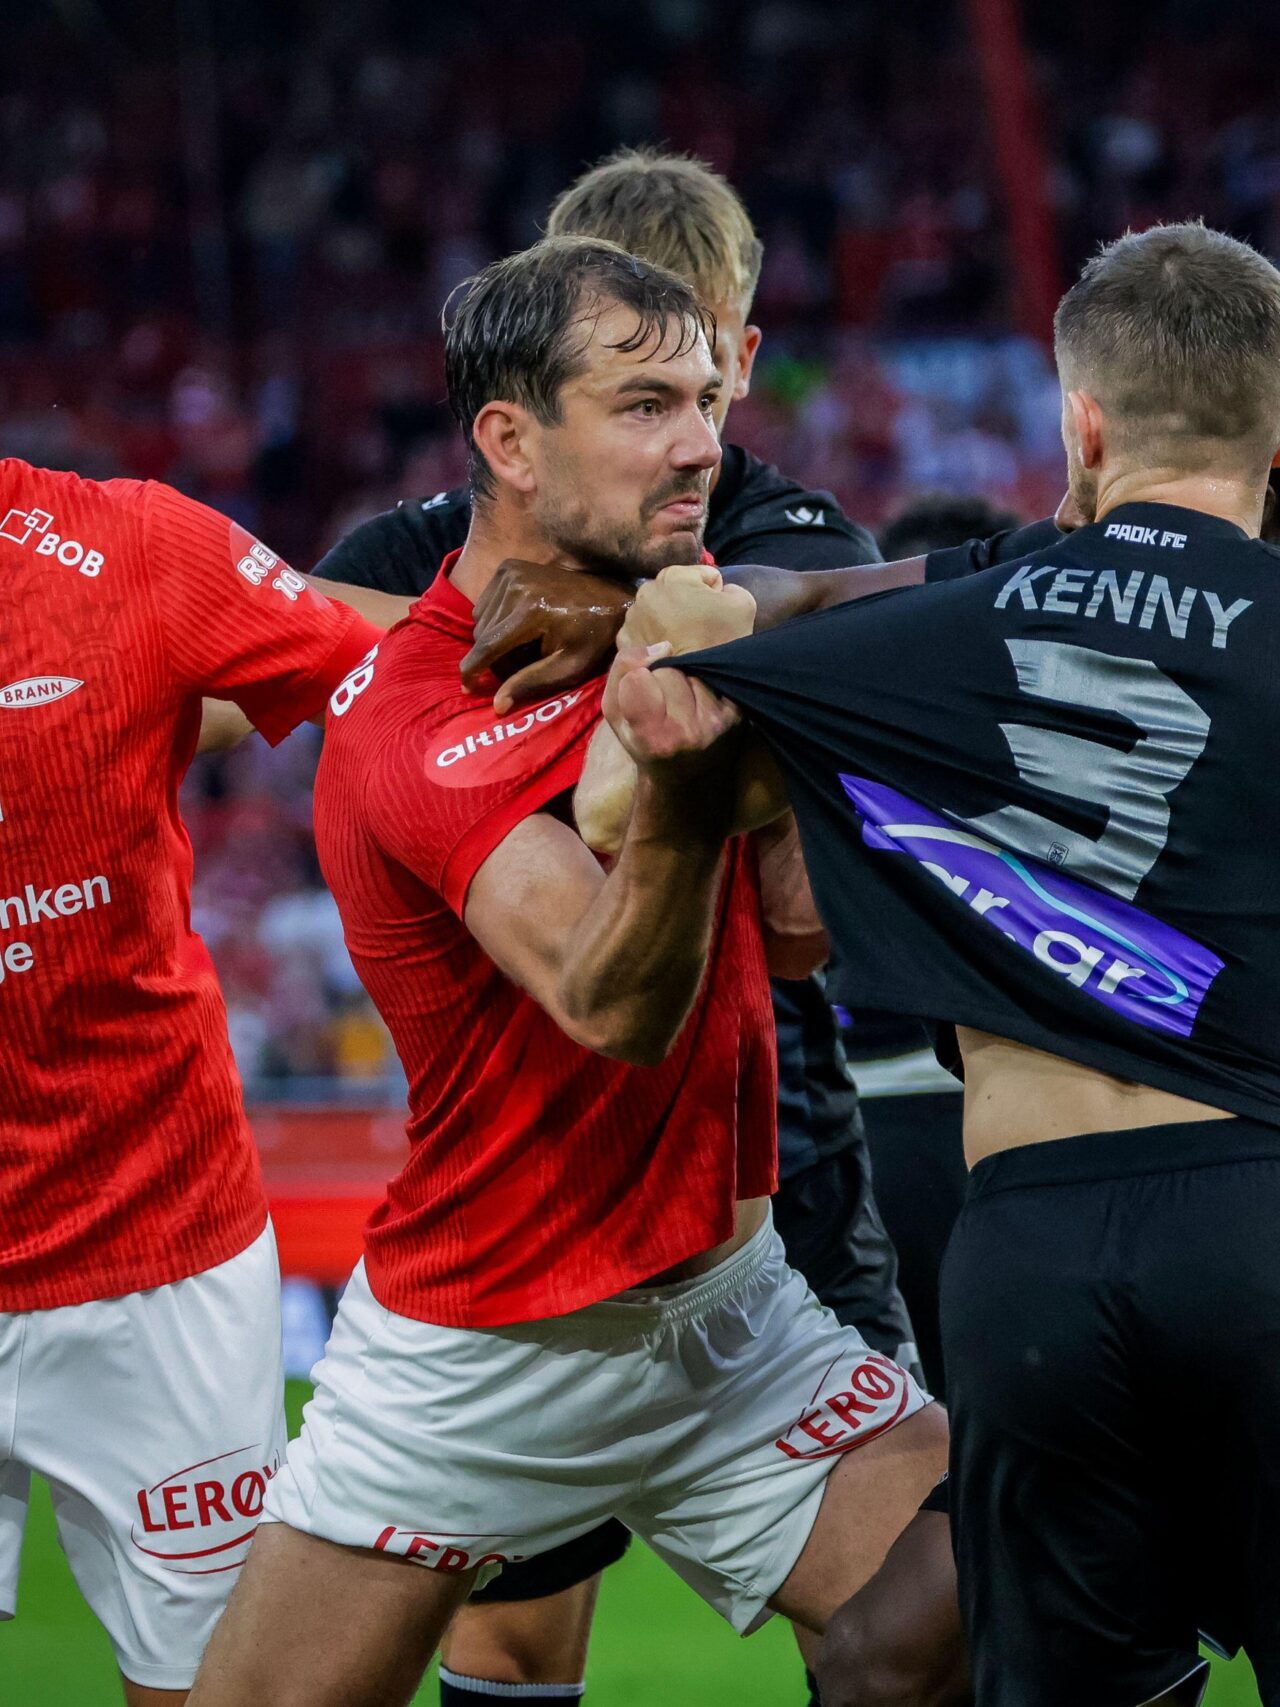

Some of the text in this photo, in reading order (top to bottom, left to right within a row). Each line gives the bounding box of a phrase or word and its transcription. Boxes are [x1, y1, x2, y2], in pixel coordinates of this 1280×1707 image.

[35, 532, 105, 578] BOB
[1104, 523, 1188, 549] PAOK FC
[237, 540, 280, 585] RE
[994, 565, 1254, 649] KENNY
[4, 681, 63, 703] BRANN
[942, 638, 1212, 901] 3
